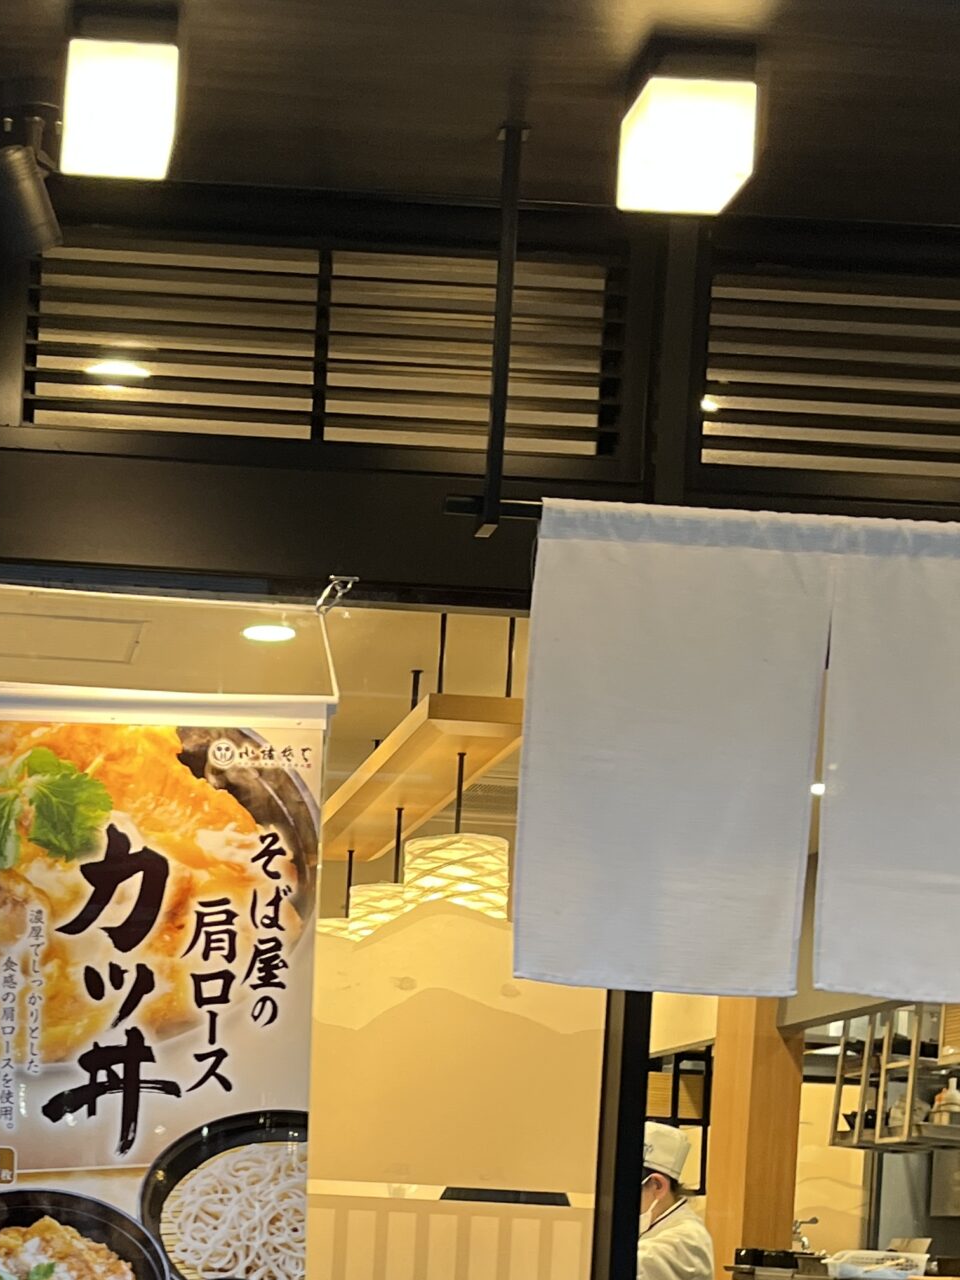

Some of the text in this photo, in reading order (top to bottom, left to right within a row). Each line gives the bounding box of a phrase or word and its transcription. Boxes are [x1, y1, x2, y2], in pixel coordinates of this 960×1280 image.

[27, 909, 45, 1074] 濃厚でしっかりとした
[42, 824, 182, 1155] カツ丼
[182, 899, 239, 1093] 肩ロース
[242, 831, 291, 1028] そば屋の
